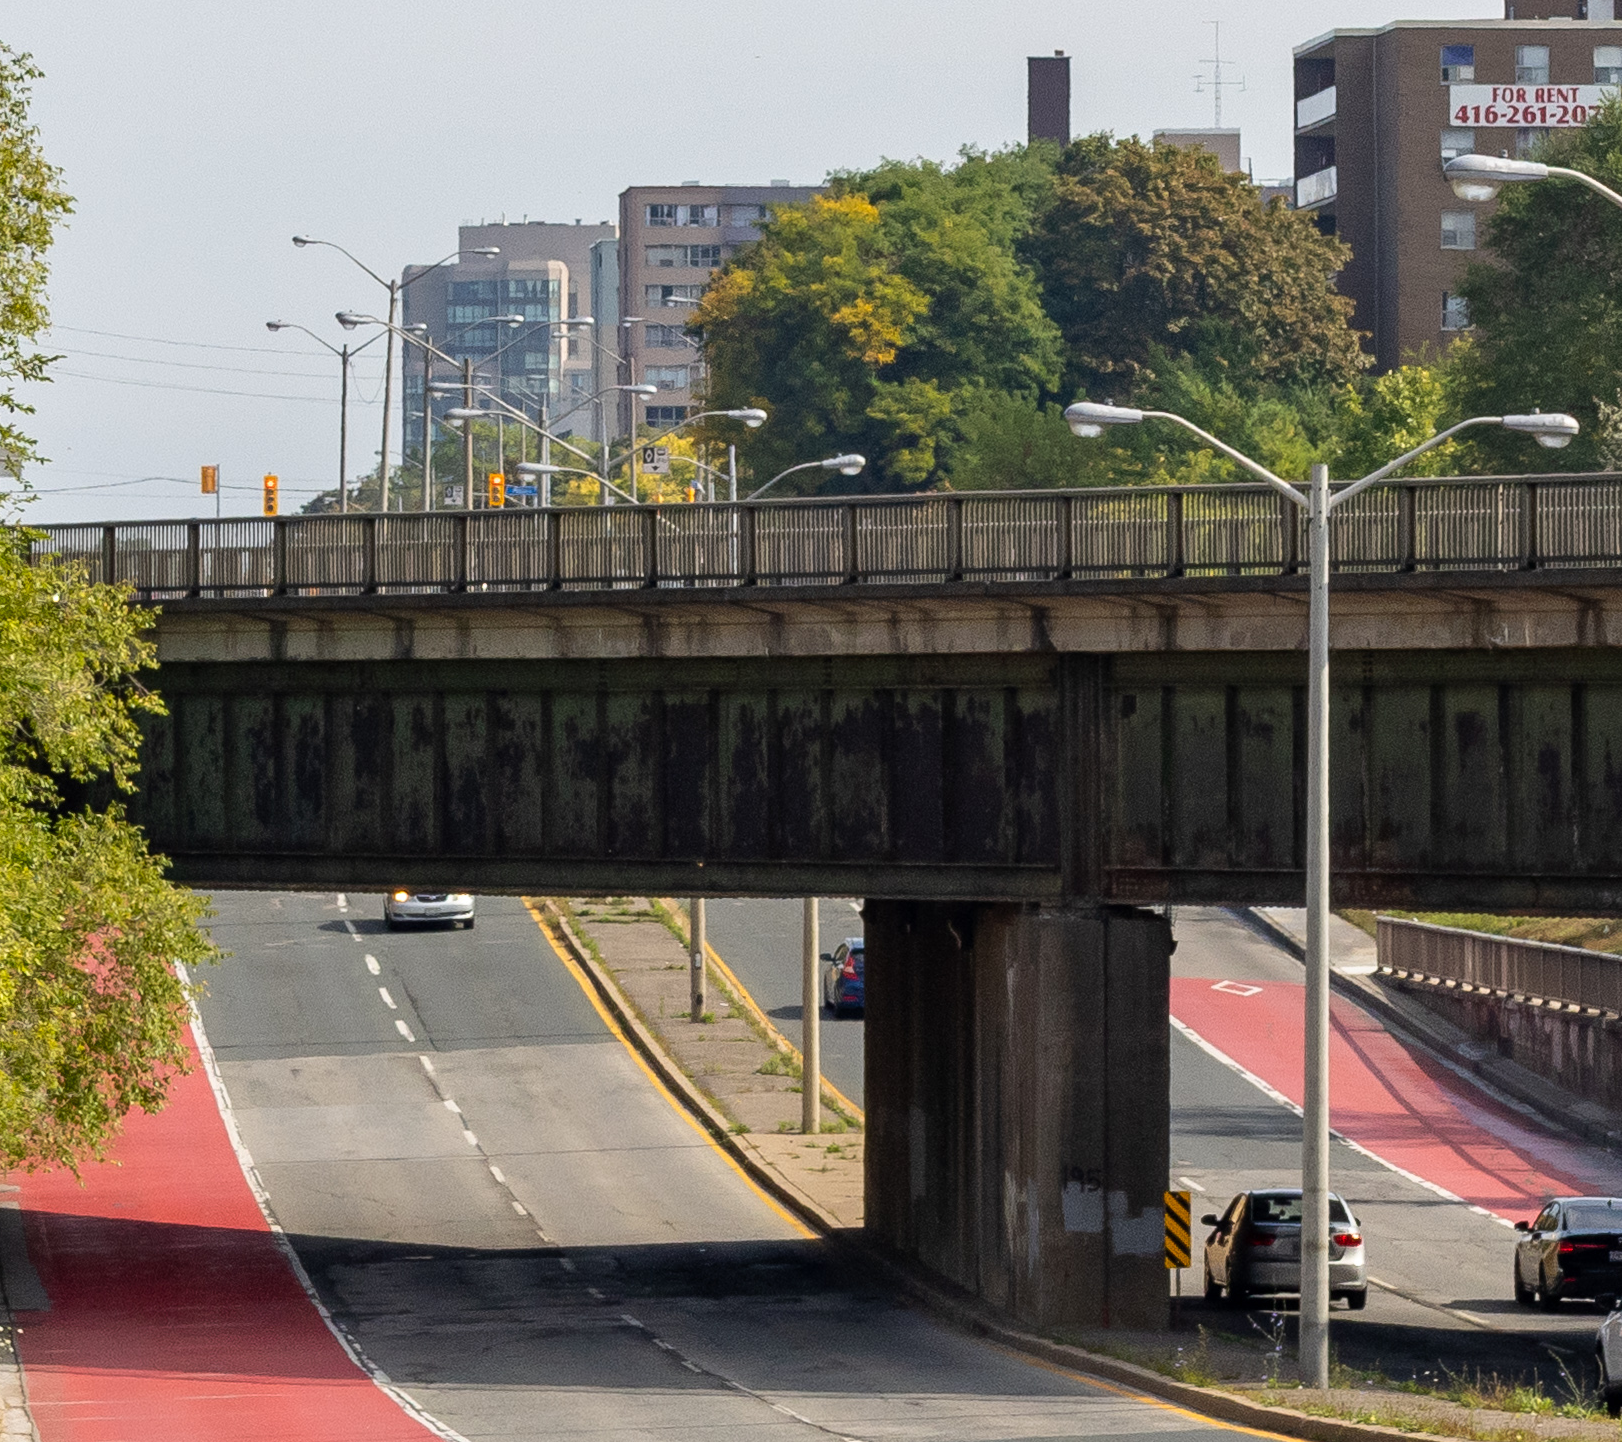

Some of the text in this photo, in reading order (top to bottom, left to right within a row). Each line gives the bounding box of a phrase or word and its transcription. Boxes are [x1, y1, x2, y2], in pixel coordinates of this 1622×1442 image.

[1491, 87, 1580, 104] FOR RENT
[1454, 105, 1602, 125] 416-261-207
